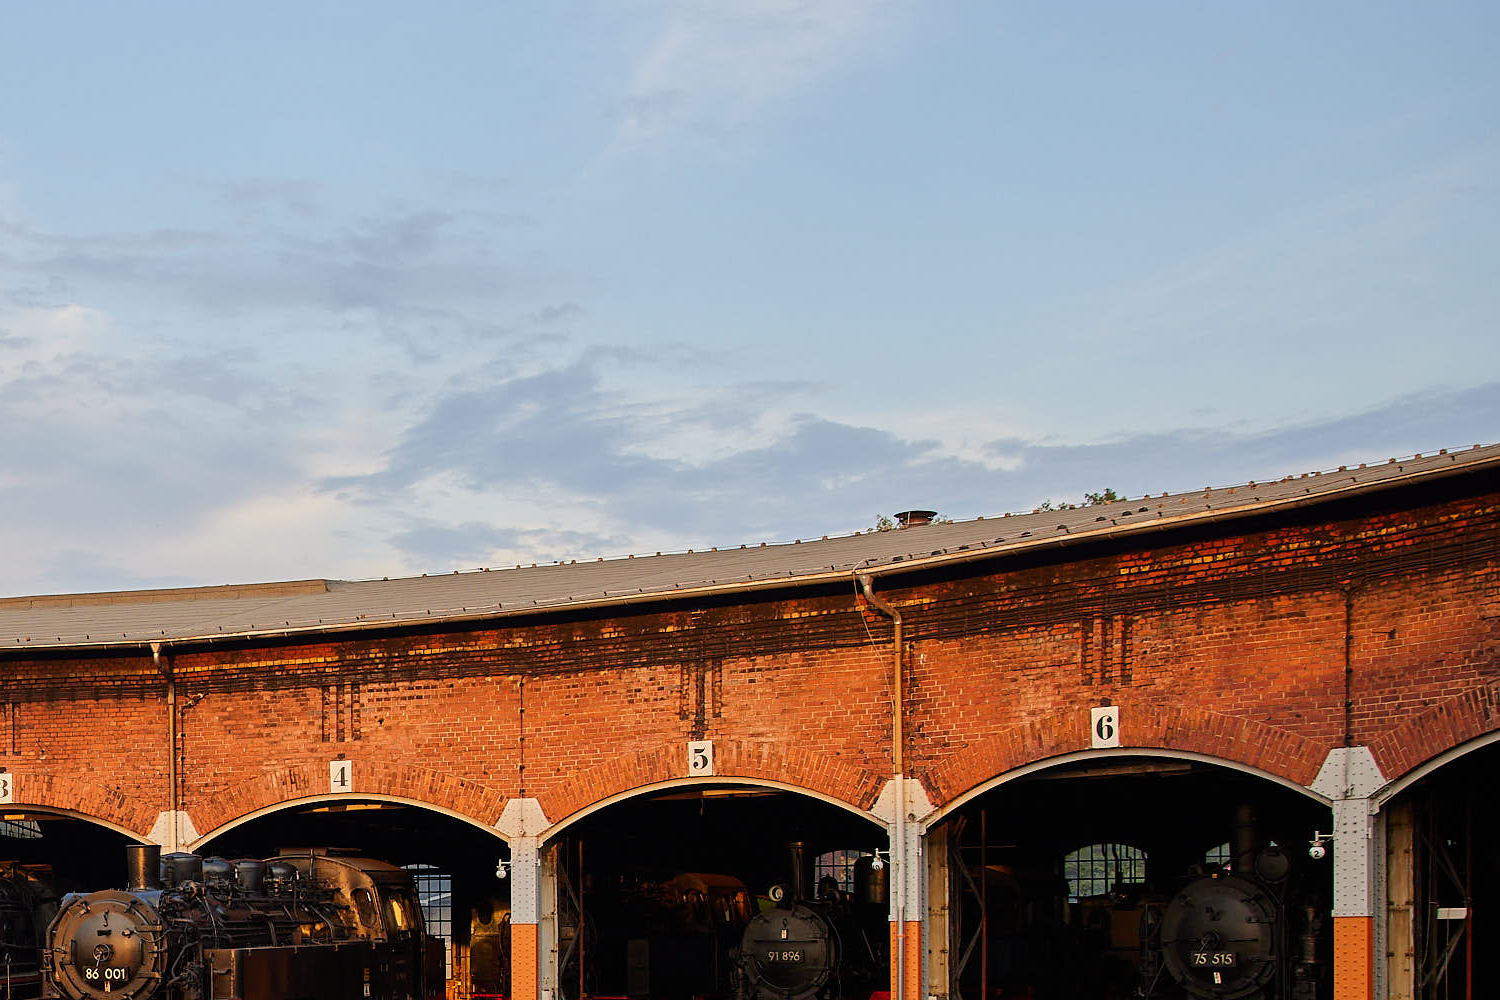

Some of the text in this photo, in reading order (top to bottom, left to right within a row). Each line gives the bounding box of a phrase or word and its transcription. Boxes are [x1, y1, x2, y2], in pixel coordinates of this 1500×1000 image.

[1096, 714, 1113, 740] 6
[693, 747, 708, 769] 5
[333, 766, 348, 787] 4
[768, 951, 800, 961] 91 896
[1193, 953, 1233, 965] 75 515
[85, 967, 125, 980] 86 001
